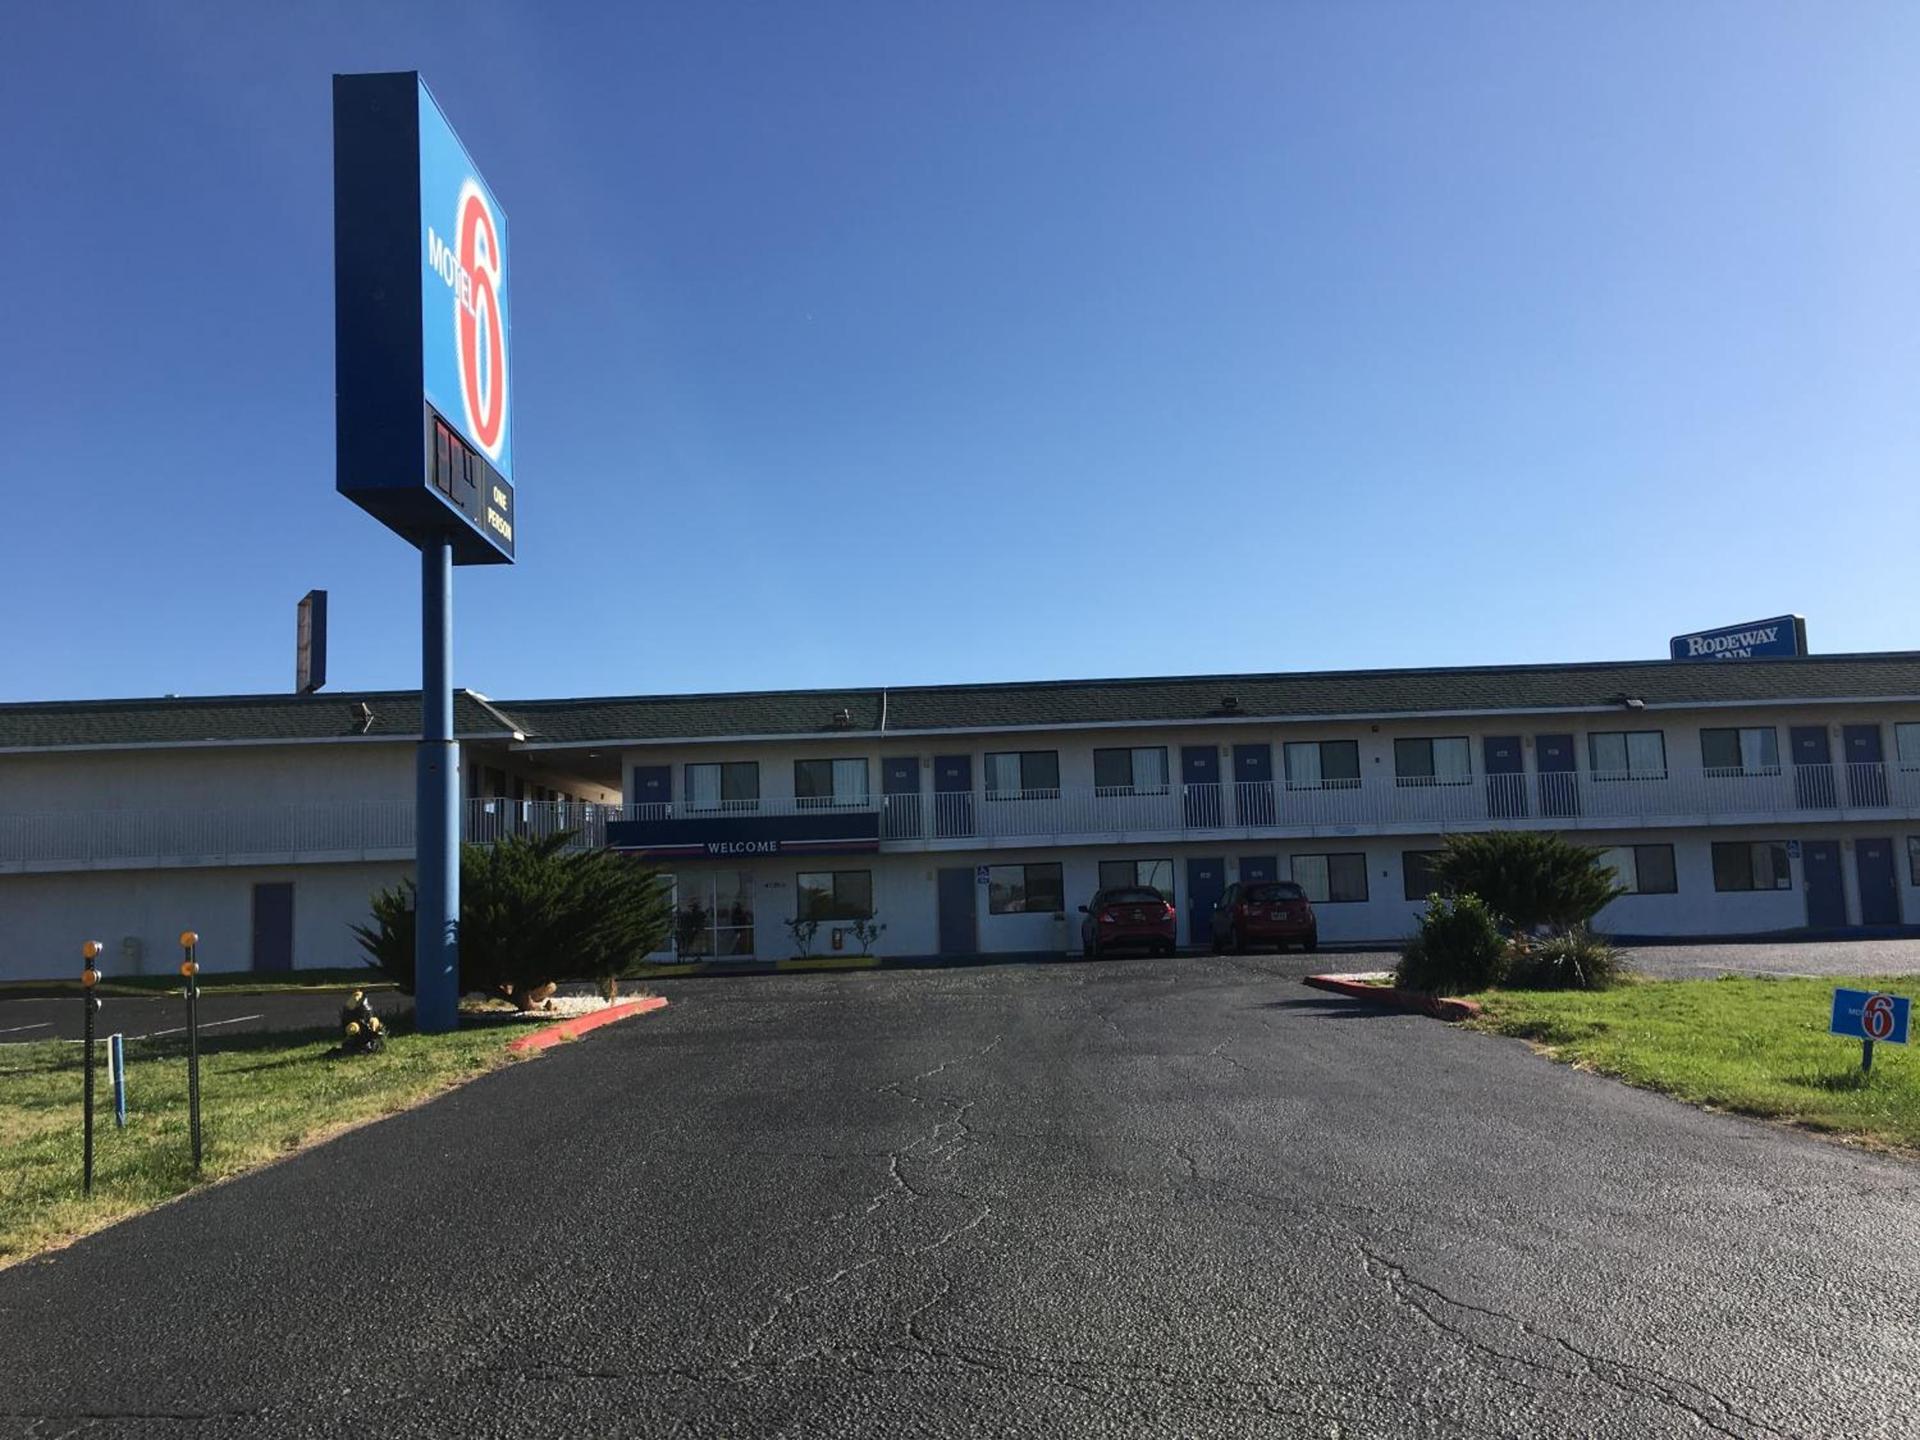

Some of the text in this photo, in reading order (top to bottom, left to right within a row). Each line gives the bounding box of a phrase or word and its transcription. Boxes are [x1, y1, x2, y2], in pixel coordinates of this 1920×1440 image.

[428, 180, 506, 457] MOTEL 6
[493, 486, 508, 511] ONE
[487, 507, 512, 542] PERSON
[1687, 627, 1778, 656] RODEWAY
[708, 841, 777, 853] WELCOME
[1862, 994, 1895, 1041] 6
